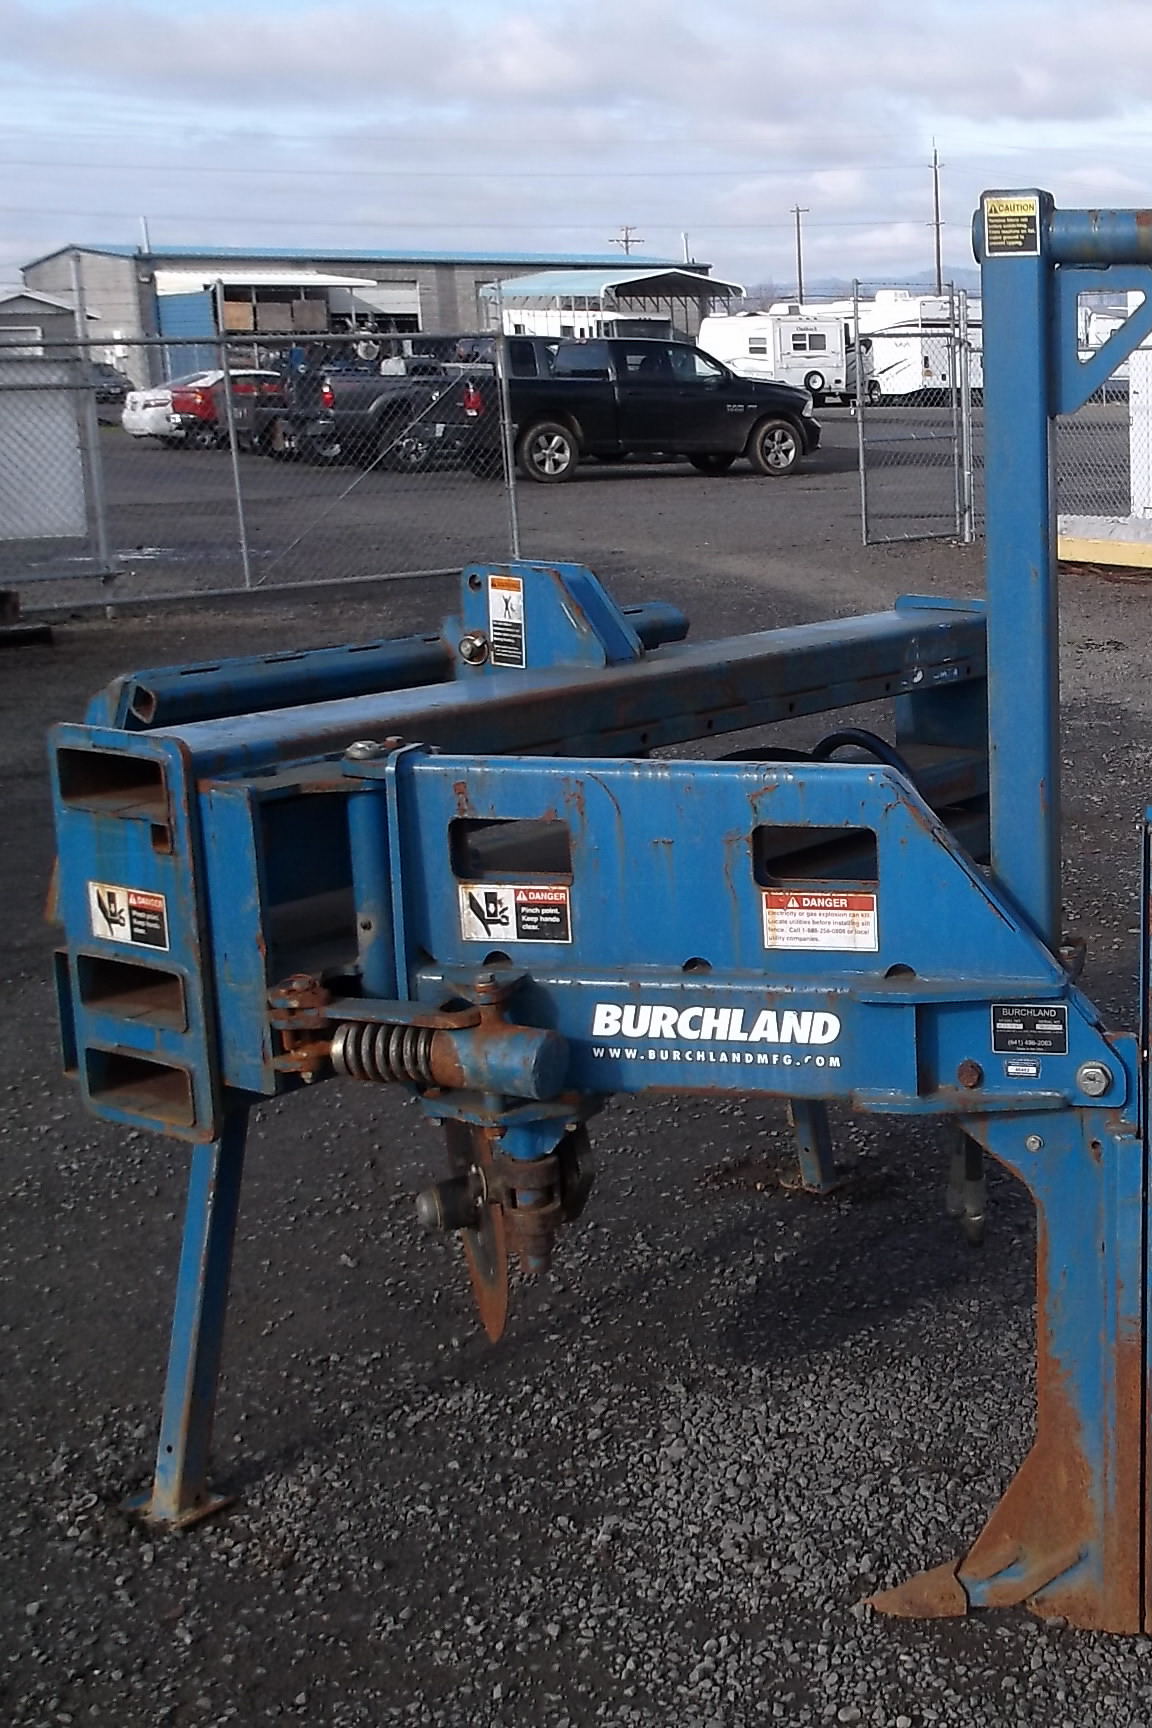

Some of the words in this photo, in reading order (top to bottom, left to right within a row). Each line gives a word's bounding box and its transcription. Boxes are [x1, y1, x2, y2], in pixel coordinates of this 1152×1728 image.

[999, 203, 1035, 213] CAUTION
[137, 895, 162, 906] DANGER
[528, 892, 566, 901] DANGER
[802, 897, 848, 908] DANGER
[521, 906, 541, 914] Pinch
[521, 915, 539, 923] Keep
[1002, 1008, 1057, 1017] BURCHLAND
[593, 1003, 841, 1045] BURCHLAND
